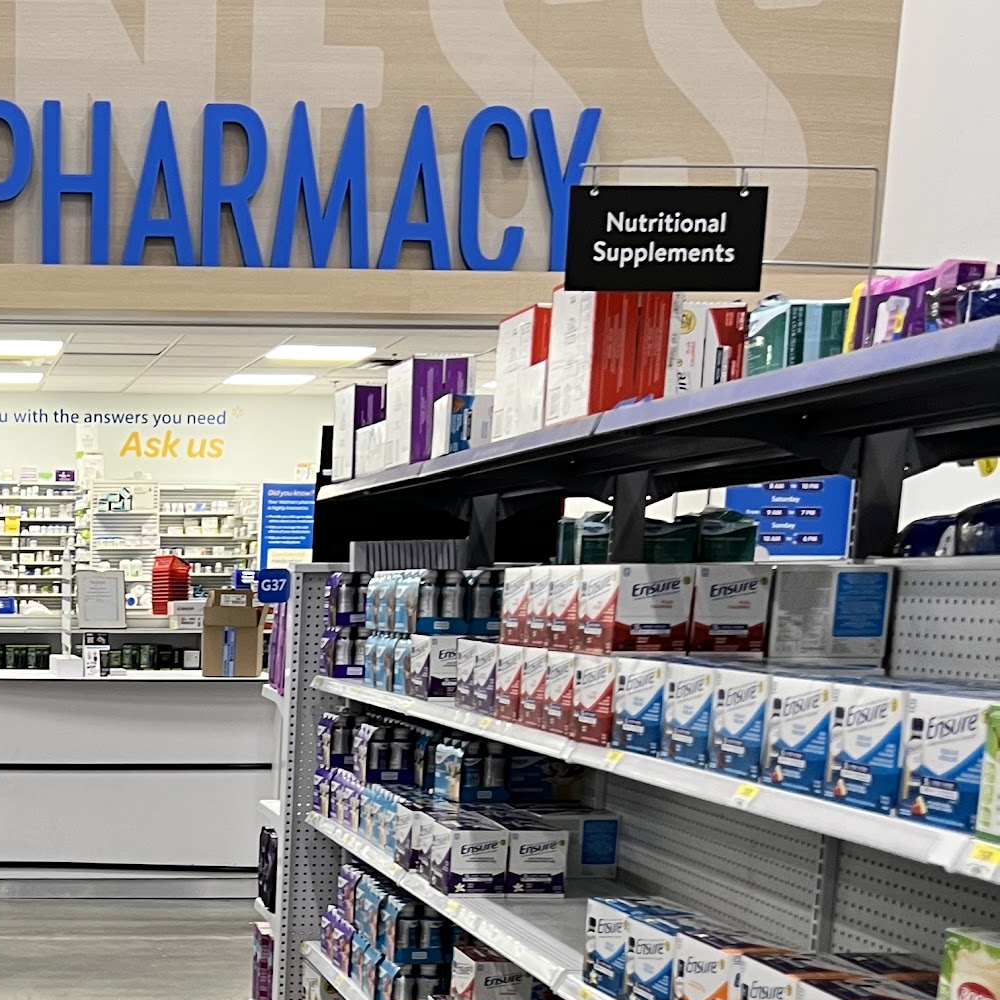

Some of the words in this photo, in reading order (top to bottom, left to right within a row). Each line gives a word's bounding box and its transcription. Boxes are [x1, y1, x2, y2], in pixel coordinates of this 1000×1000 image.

[605, 210, 728, 235] Nutritional
[592, 241, 736, 268] Supplements
[14, 409, 48, 423] with
[53, 409, 79, 423] the
[83, 412, 148, 425] answers
[153, 413, 182, 427] you
[187, 411, 227, 425] need
[119, 430, 178, 458] Ask
[186, 437, 225, 459] us
[771, 522, 796, 530] Sunday
[260, 578, 287, 591] G37
[632, 579, 681, 597] Ensure
[710, 580, 759, 598] Ensure
[726, 684, 757, 707] Ensure
[783, 693, 820, 716] Ensure
[846, 703, 888, 727] Ensure
[926, 713, 979, 740] Ensure
[460, 840, 500, 855] Ensure
[519, 840, 559, 855] Ensure
[597, 918, 622, 934] Ensure
[635, 939, 664, 955] Ensure
[685, 956, 718, 974] Ensure
[484, 974, 523, 986] Ensure
[750, 980, 784, 1000] Ensure
